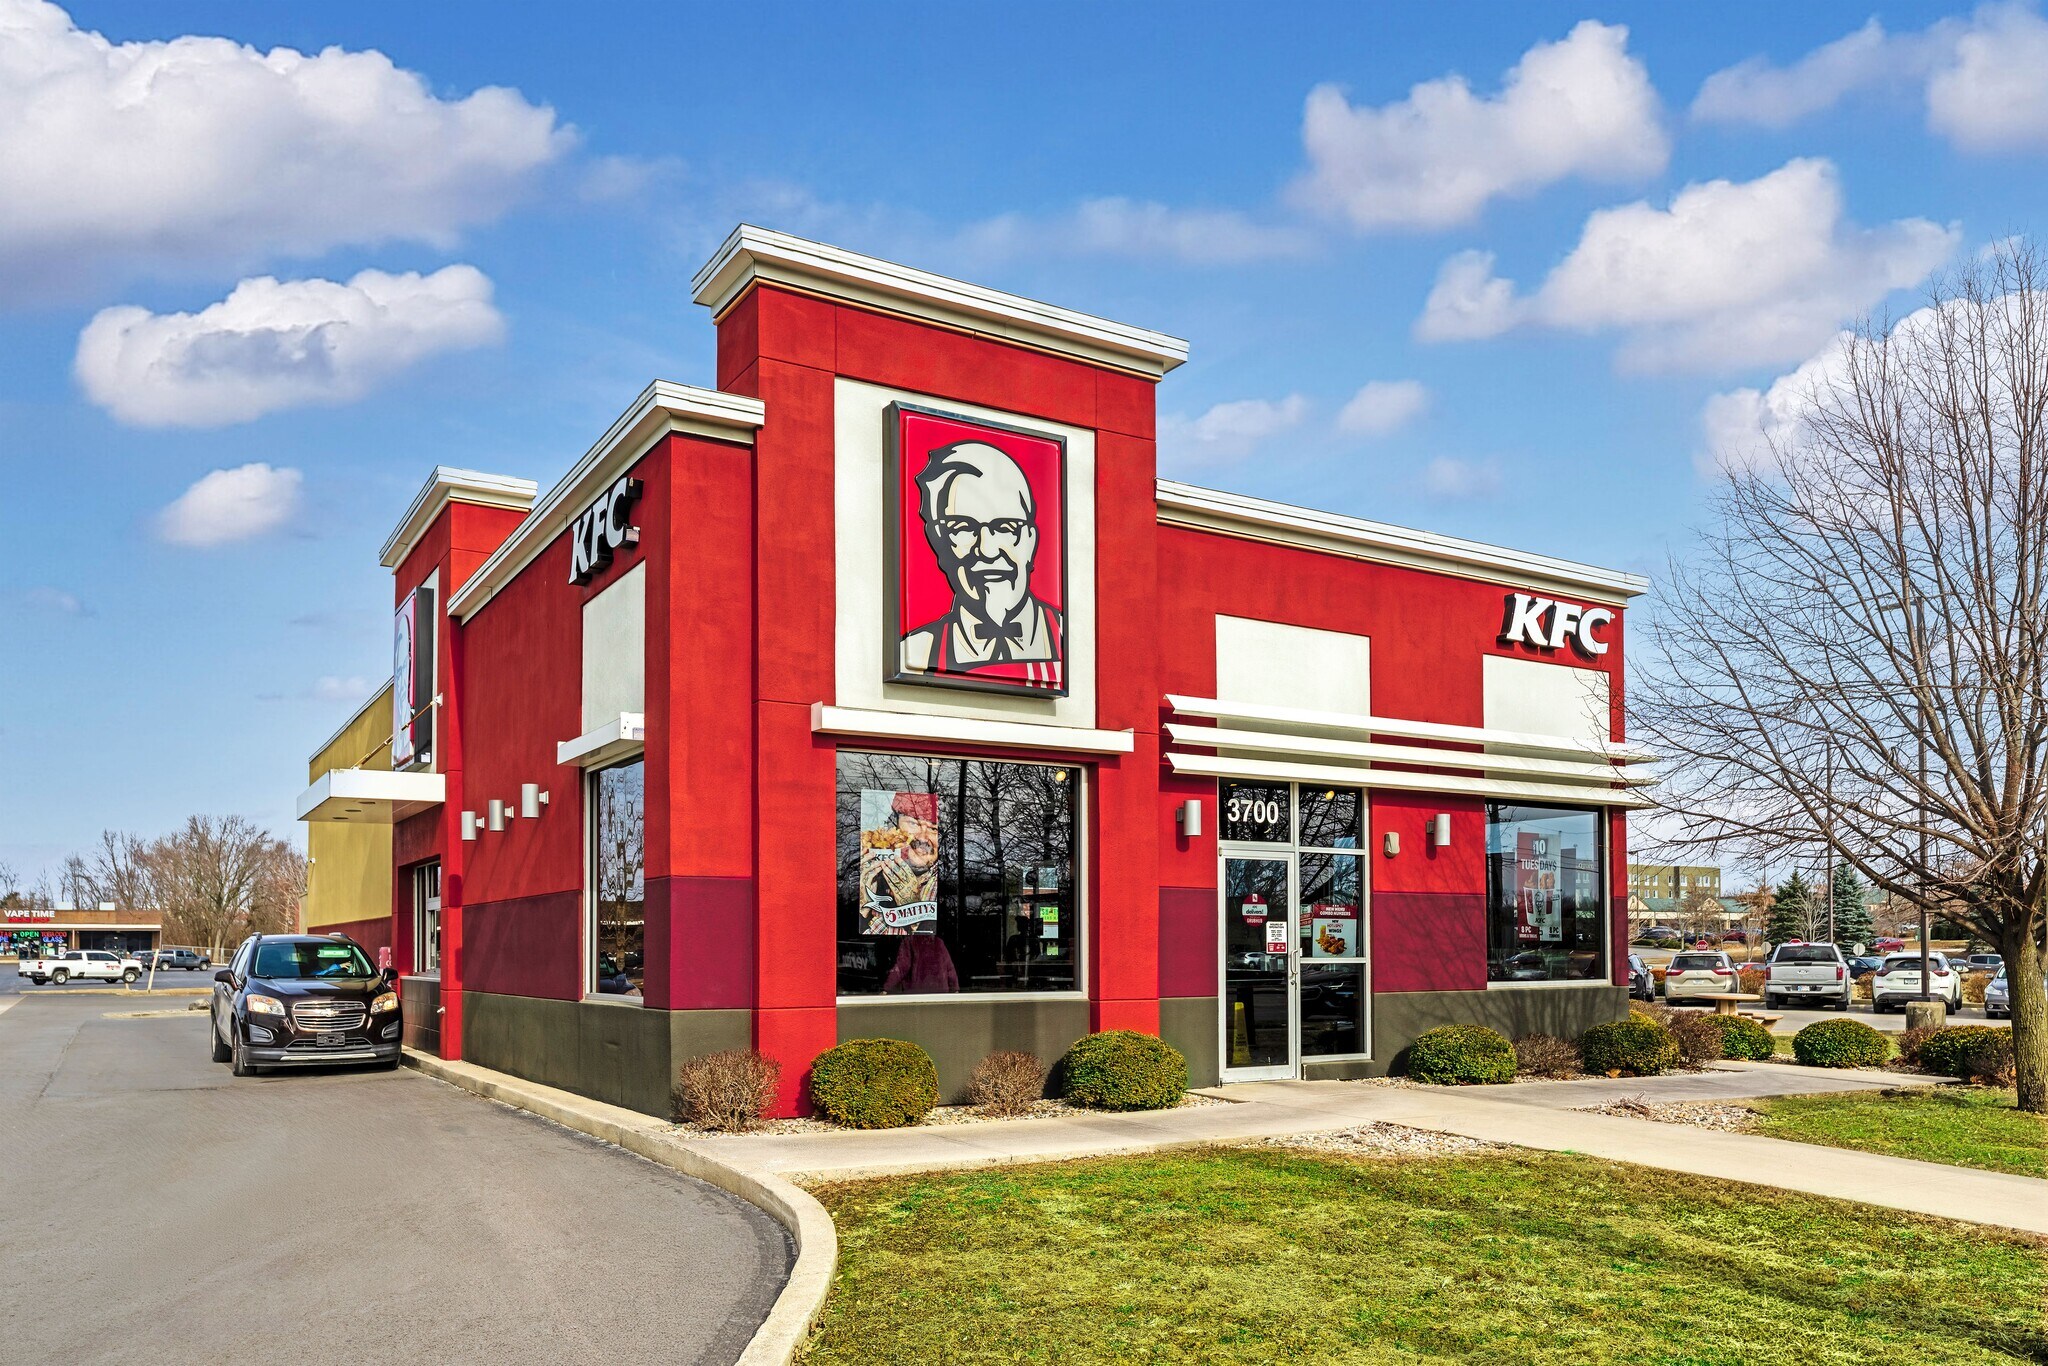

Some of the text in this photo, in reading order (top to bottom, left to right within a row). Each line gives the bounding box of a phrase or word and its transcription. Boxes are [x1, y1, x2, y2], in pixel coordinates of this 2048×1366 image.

[568, 477, 628, 586] KFC
[1505, 592, 1613, 655] KFC
[1227, 798, 1279, 824] 3700
[885, 909, 897, 923] $5
[897, 903, 936, 919] MATTY'S
